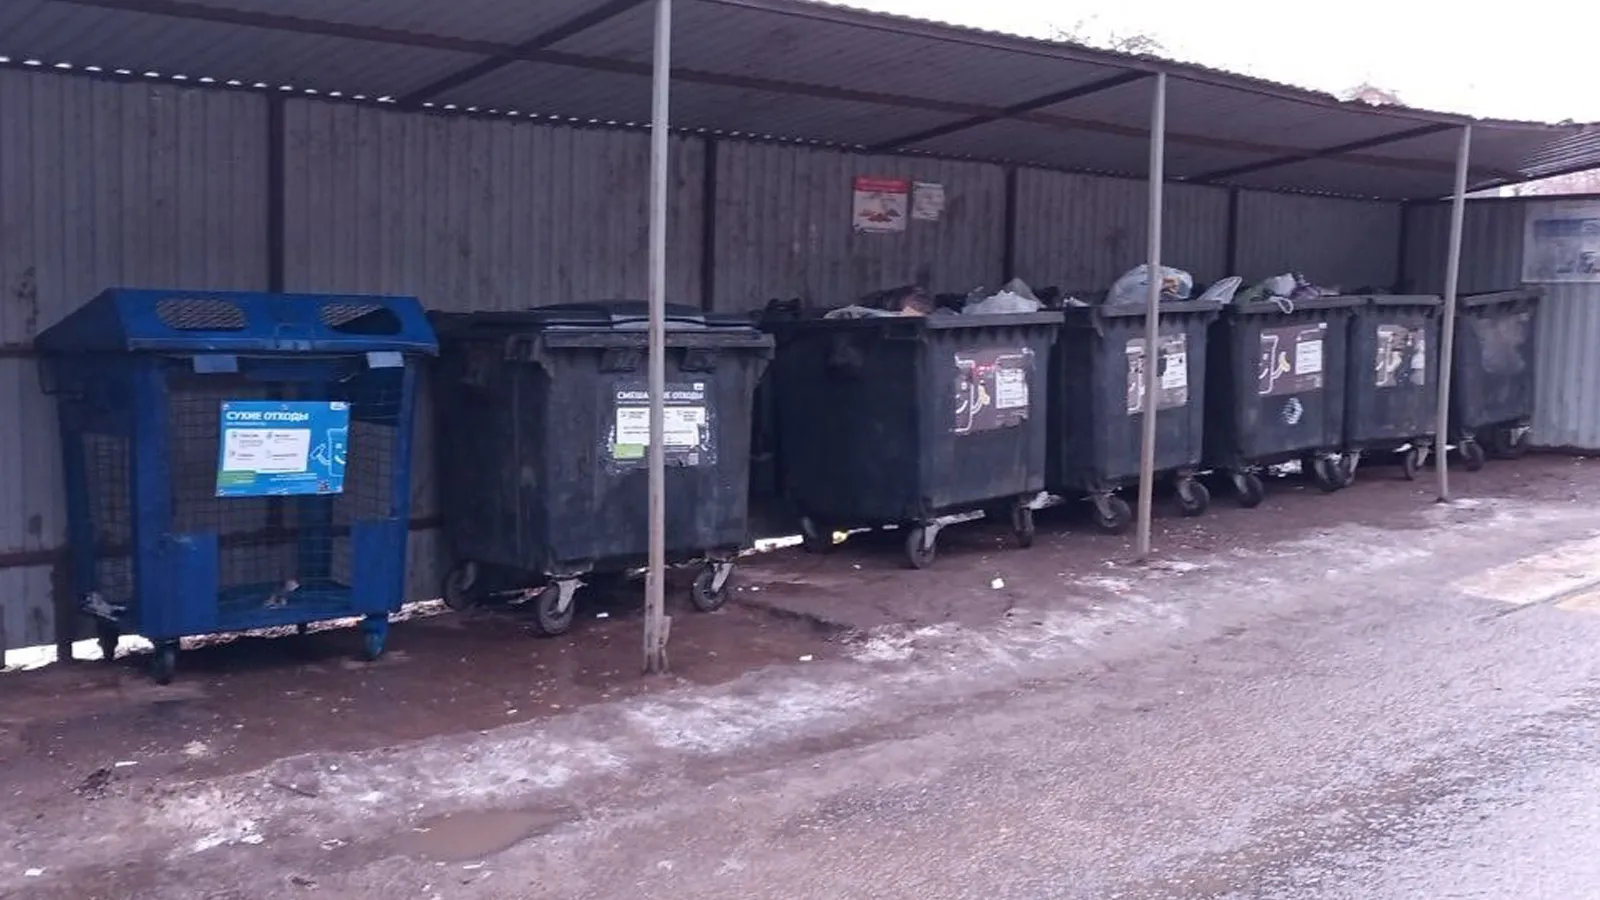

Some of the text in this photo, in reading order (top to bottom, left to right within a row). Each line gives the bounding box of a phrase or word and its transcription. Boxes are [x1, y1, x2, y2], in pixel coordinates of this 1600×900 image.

[671, 391, 704, 400] ОТХОДЫ
[226, 411, 310, 422] СУХИЕ ОТХОДЫ
